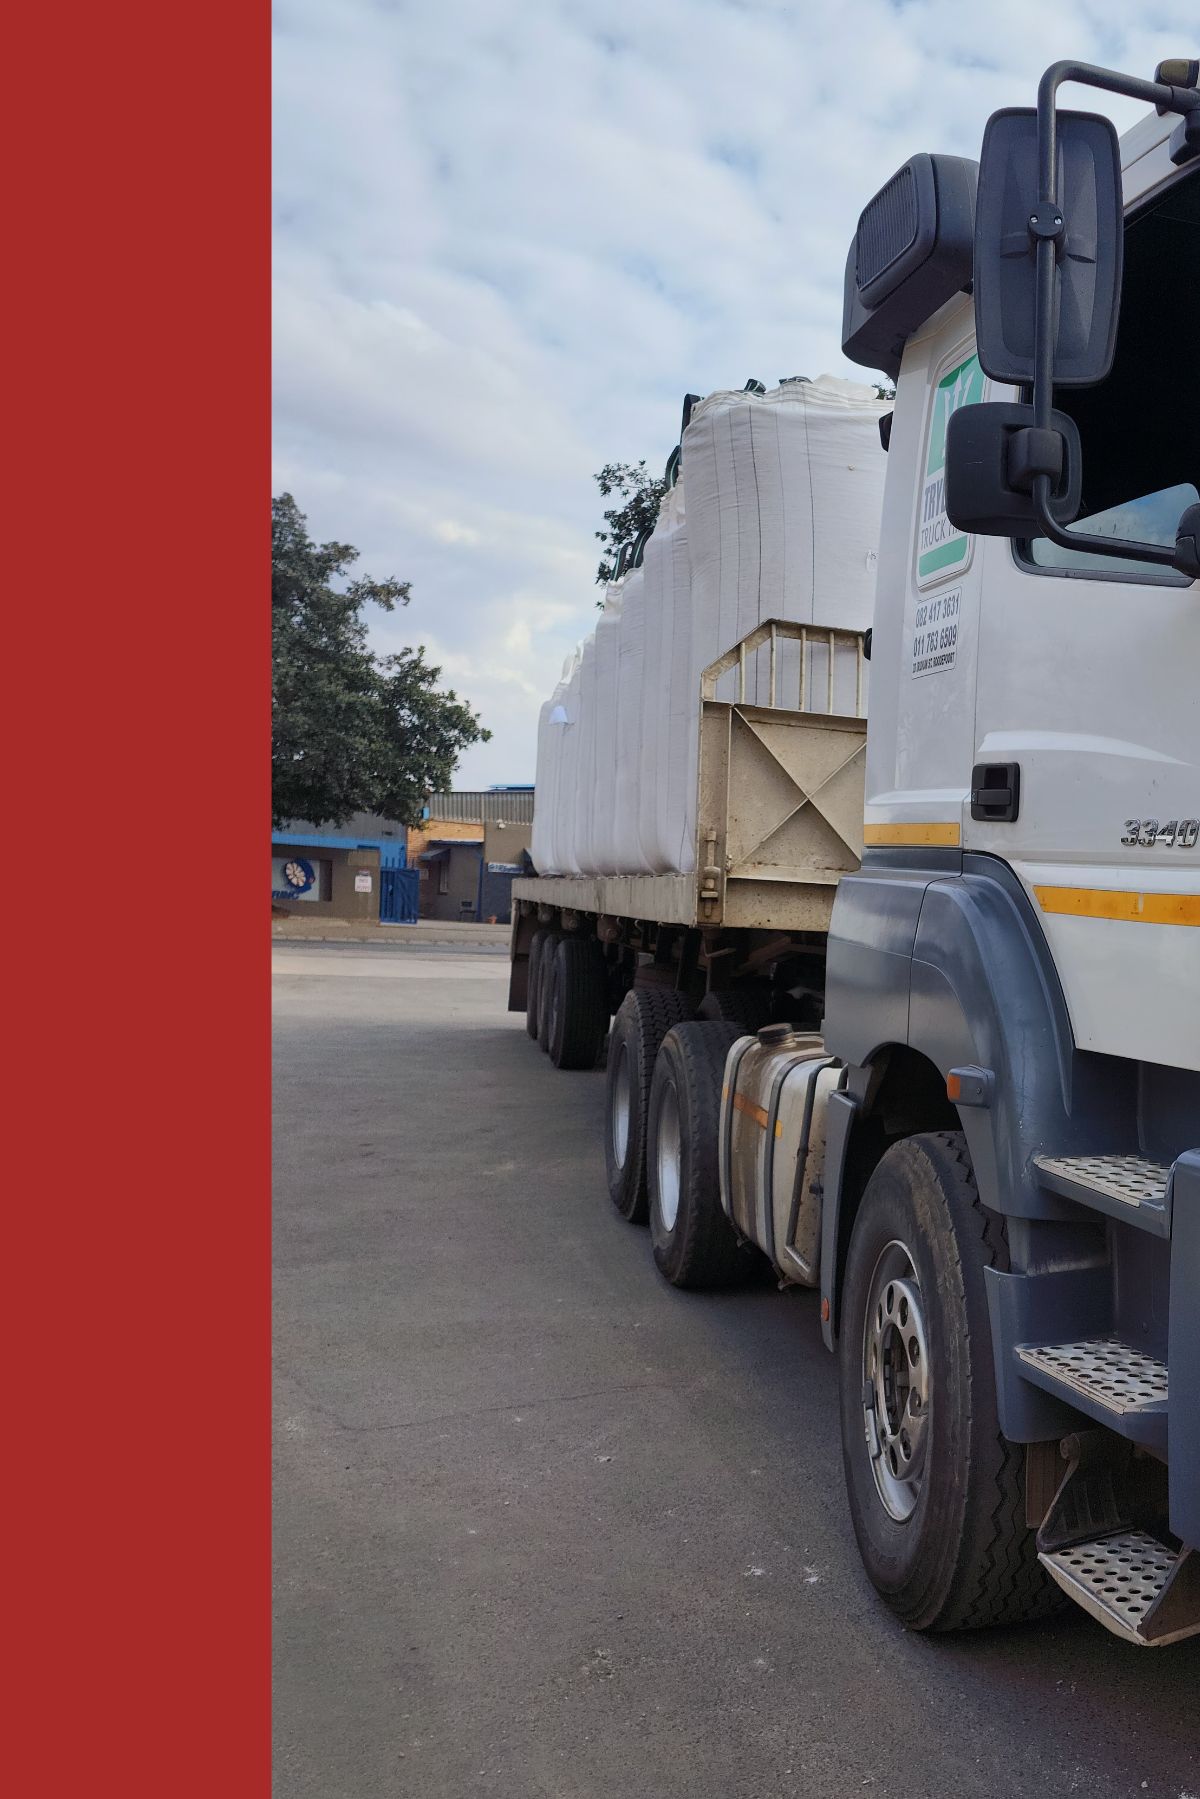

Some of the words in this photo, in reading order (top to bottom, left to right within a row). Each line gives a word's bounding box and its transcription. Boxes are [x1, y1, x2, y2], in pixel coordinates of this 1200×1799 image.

[921, 517, 947, 550] TRUCK
[916, 605, 928, 628] 082
[929, 601, 942, 623] 417
[943, 593, 960, 619] 3631
[913, 635, 925, 657] 011
[927, 630, 939, 653] 763
[940, 624, 957, 649] 6509
[1120, 818, 1200, 848] 3340
